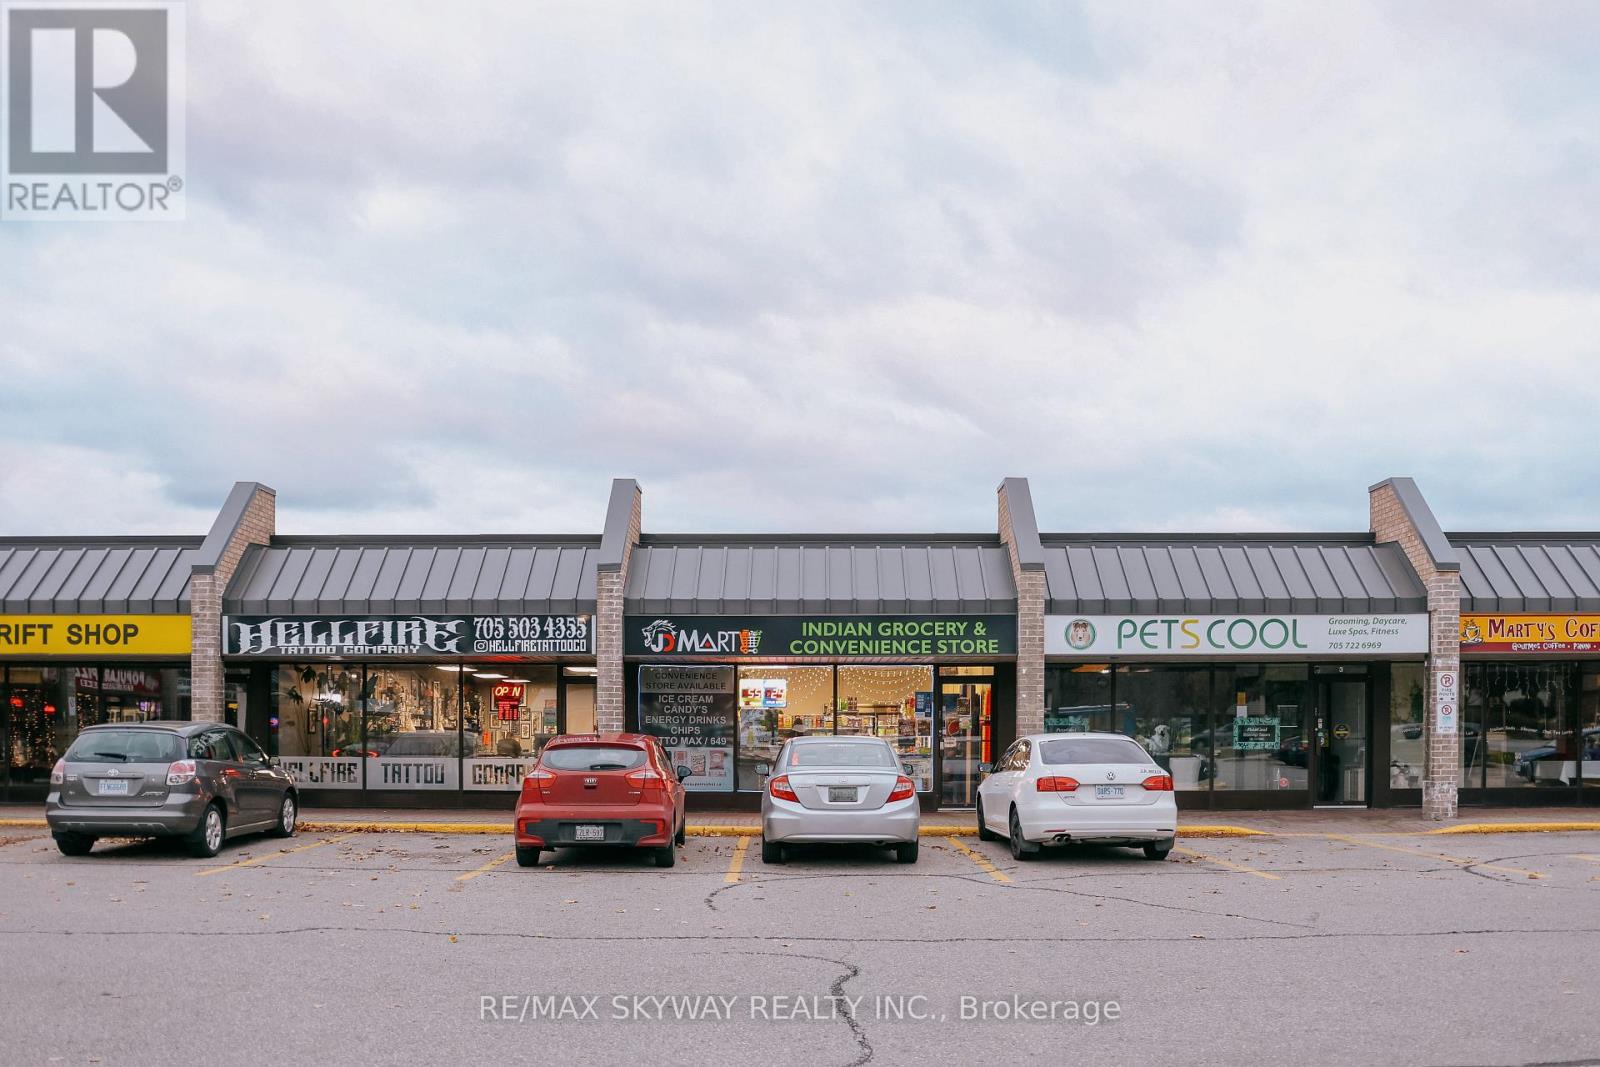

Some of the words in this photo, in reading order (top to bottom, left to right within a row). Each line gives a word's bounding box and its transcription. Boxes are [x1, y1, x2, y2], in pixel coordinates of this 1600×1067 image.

[1328, 617, 1371, 626] Grooming,
[1372, 617, 1408, 625] Daycare,
[473, 617, 504, 639] 705
[508, 617, 541, 639] 503
[544, 617, 587, 639] 4355
[802, 622, 872, 636] INDIAN
[878, 622, 968, 636] GROCERY
[973, 622, 987, 636] &
[1348, 628, 1369, 636] Spas,
[1371, 627, 1399, 635] Fitness
[66, 623, 139, 645] SHOP
[230, 617, 466, 655] HELLFIRE
[1118, 618, 1200, 649] PETS
[1206, 618, 1308, 649] COOL
[279, 645, 336, 654] TATTOO
[344, 645, 420, 654] COMPANY
[789, 640, 931, 654] CONVENIENCE
[937, 639, 999, 654] STORE
[655, 672, 717, 680] CONVENIENCE
[646, 682, 677, 690] STORE
[678, 682, 727, 690] AVAILABLE
[495, 686, 520, 697] OPN
[658, 695, 675, 703] ICE
[677, 695, 714, 703] CREAM
[664, 705, 708, 714] CANDY'S
[645, 715, 687, 724] ENERGY
[689, 715, 727, 724] DRINKS
[670, 726, 701, 735] CHIPS
[681, 736, 702, 745] MAX
[710, 736, 727, 745] 649
[381, 763, 445, 784] TATTOO
